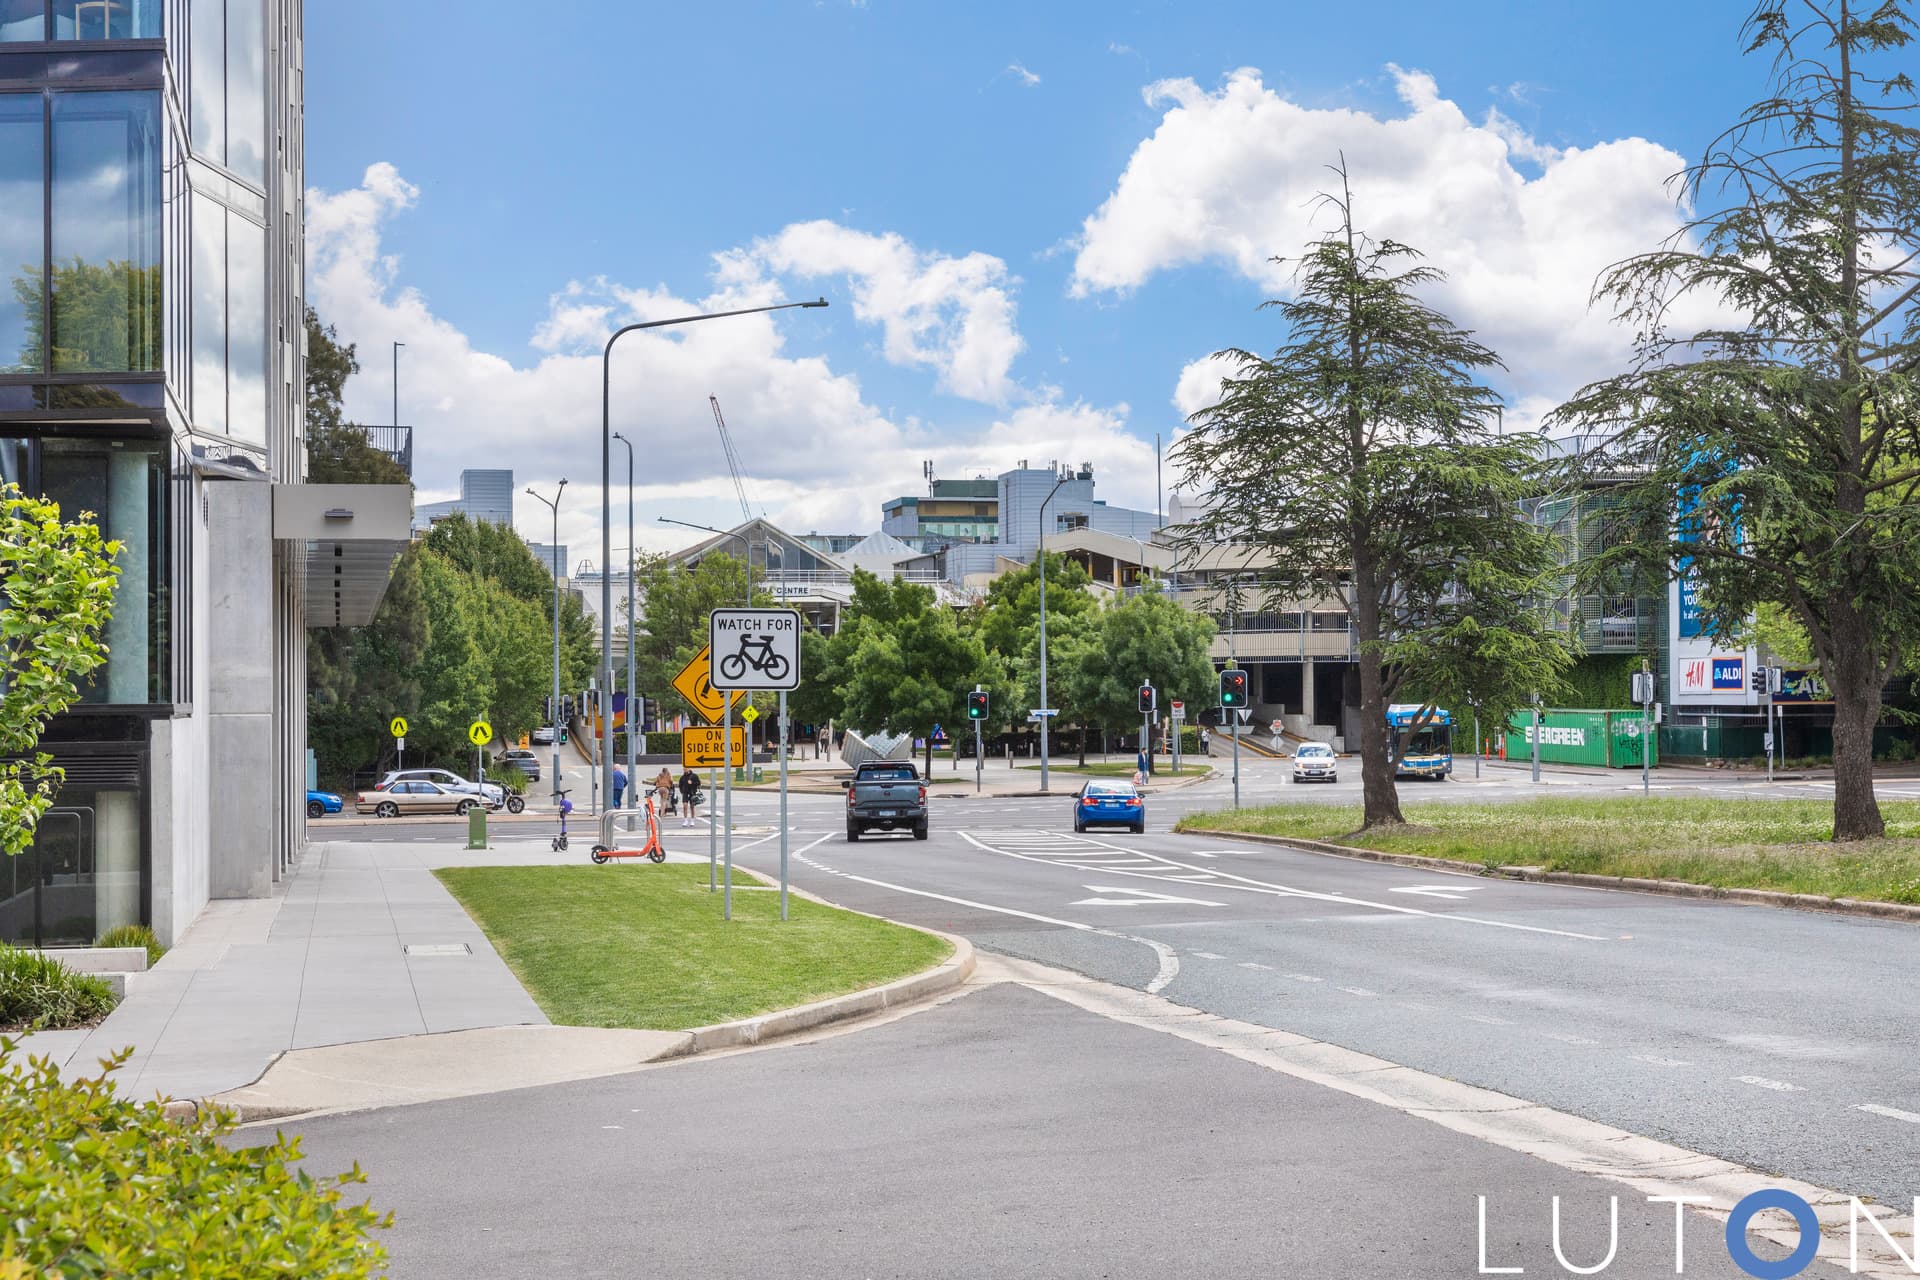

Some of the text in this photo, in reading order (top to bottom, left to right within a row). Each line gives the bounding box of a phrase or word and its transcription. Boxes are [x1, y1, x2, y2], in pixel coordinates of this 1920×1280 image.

[718, 619, 793, 631] WATCH FOR
[1686, 660, 1705, 688] H&M
[1722, 667, 1742, 680] ALDI
[705, 730, 722, 741] ON
[1525, 726, 1585, 746] EERGREEN
[687, 743, 742, 753] SIDE ROAD
